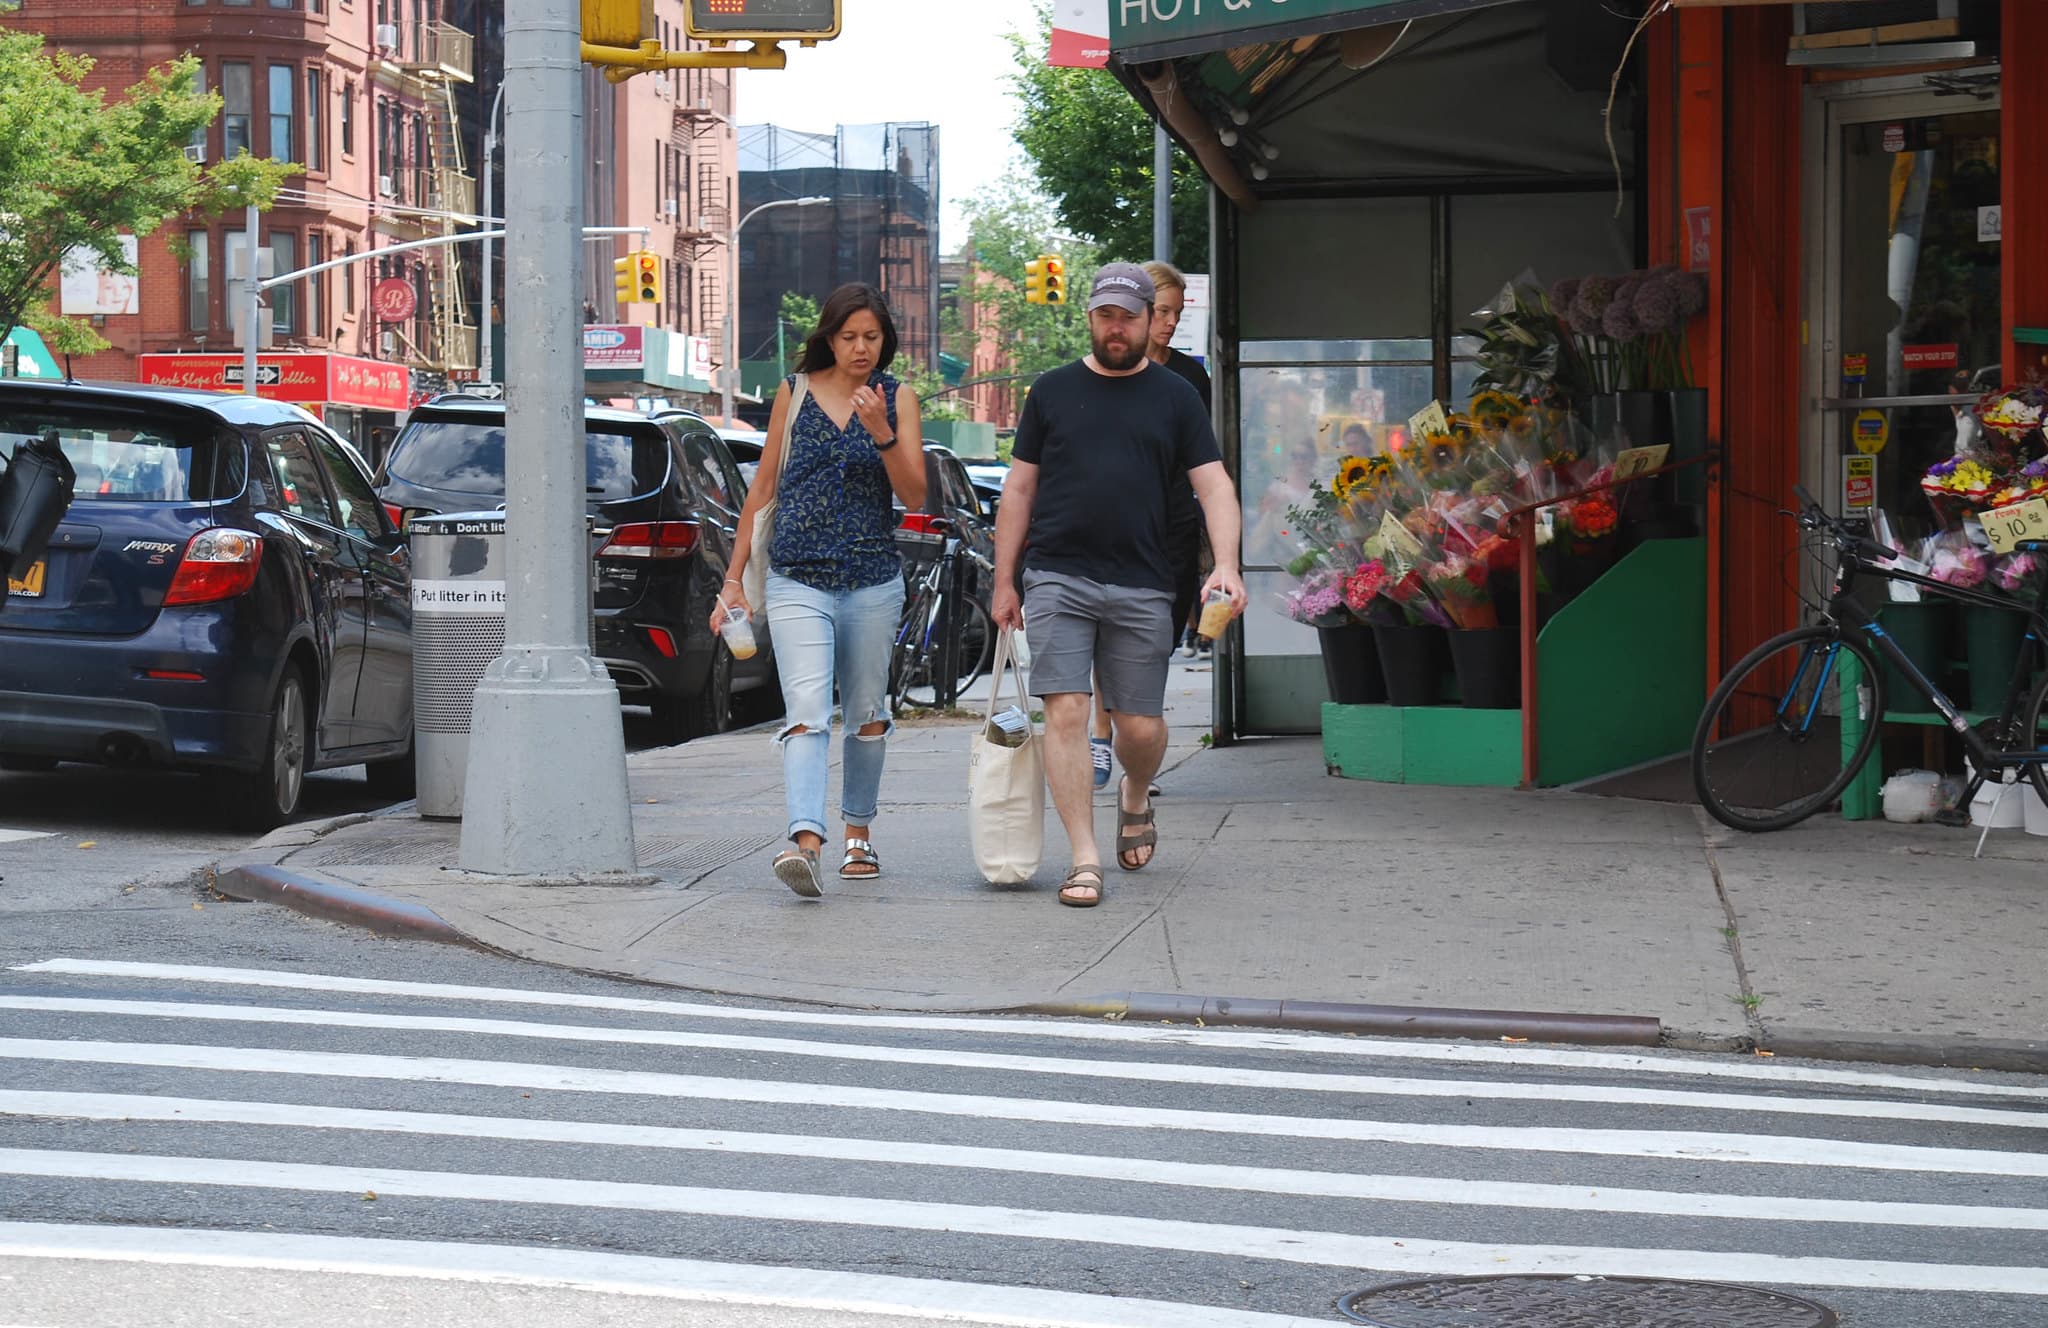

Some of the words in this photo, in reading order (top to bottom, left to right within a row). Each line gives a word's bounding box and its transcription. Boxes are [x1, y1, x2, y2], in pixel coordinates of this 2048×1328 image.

[1904, 353, 1923, 361] WATCH
[1925, 352, 1940, 360] YOUR
[1941, 352, 1956, 360] STEP
[182, 371, 211, 388] Slope
[280, 371, 316, 384] obbler
[457, 523, 488, 533] Don't
[123, 541, 176, 552] MATRIX
[147, 555, 165, 565] S
[421, 590, 435, 601] Put
[440, 590, 470, 601] litter
[474, 590, 487, 601] in
